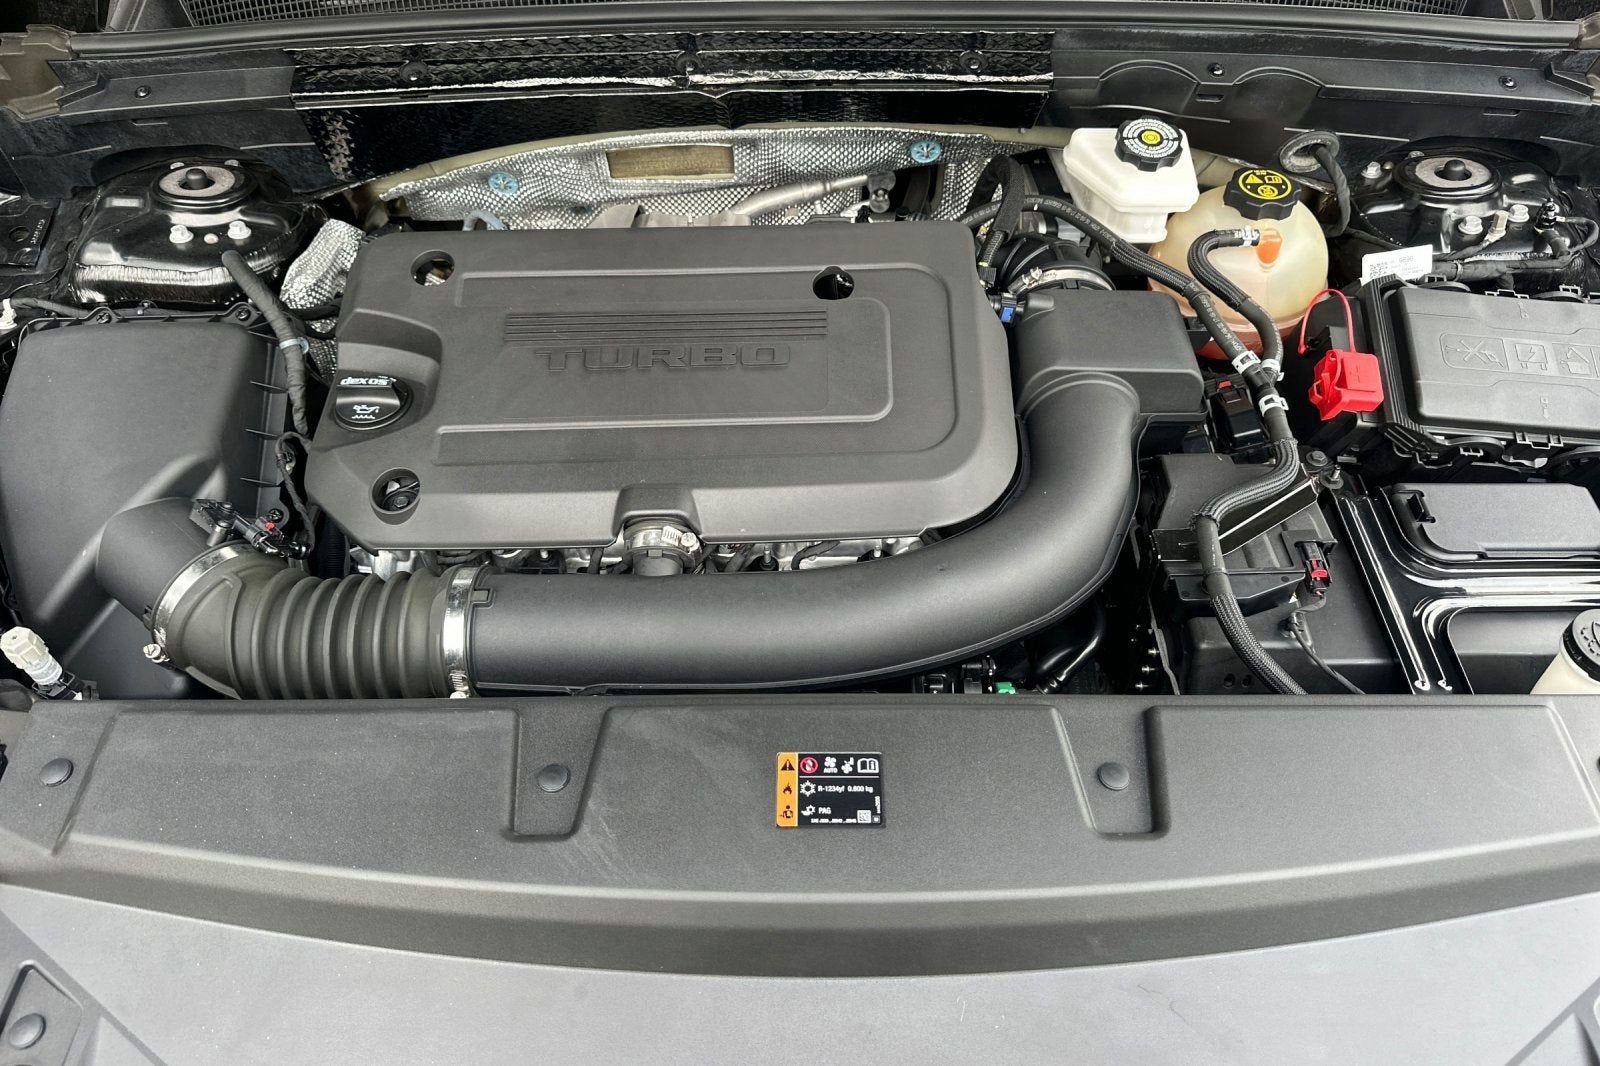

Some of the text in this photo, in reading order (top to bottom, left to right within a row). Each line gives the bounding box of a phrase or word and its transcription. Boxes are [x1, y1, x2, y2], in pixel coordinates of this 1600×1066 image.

[536, 345, 791, 371] TURBO
[865, 785, 874, 793] kg
[818, 807, 832, 815] PAG
